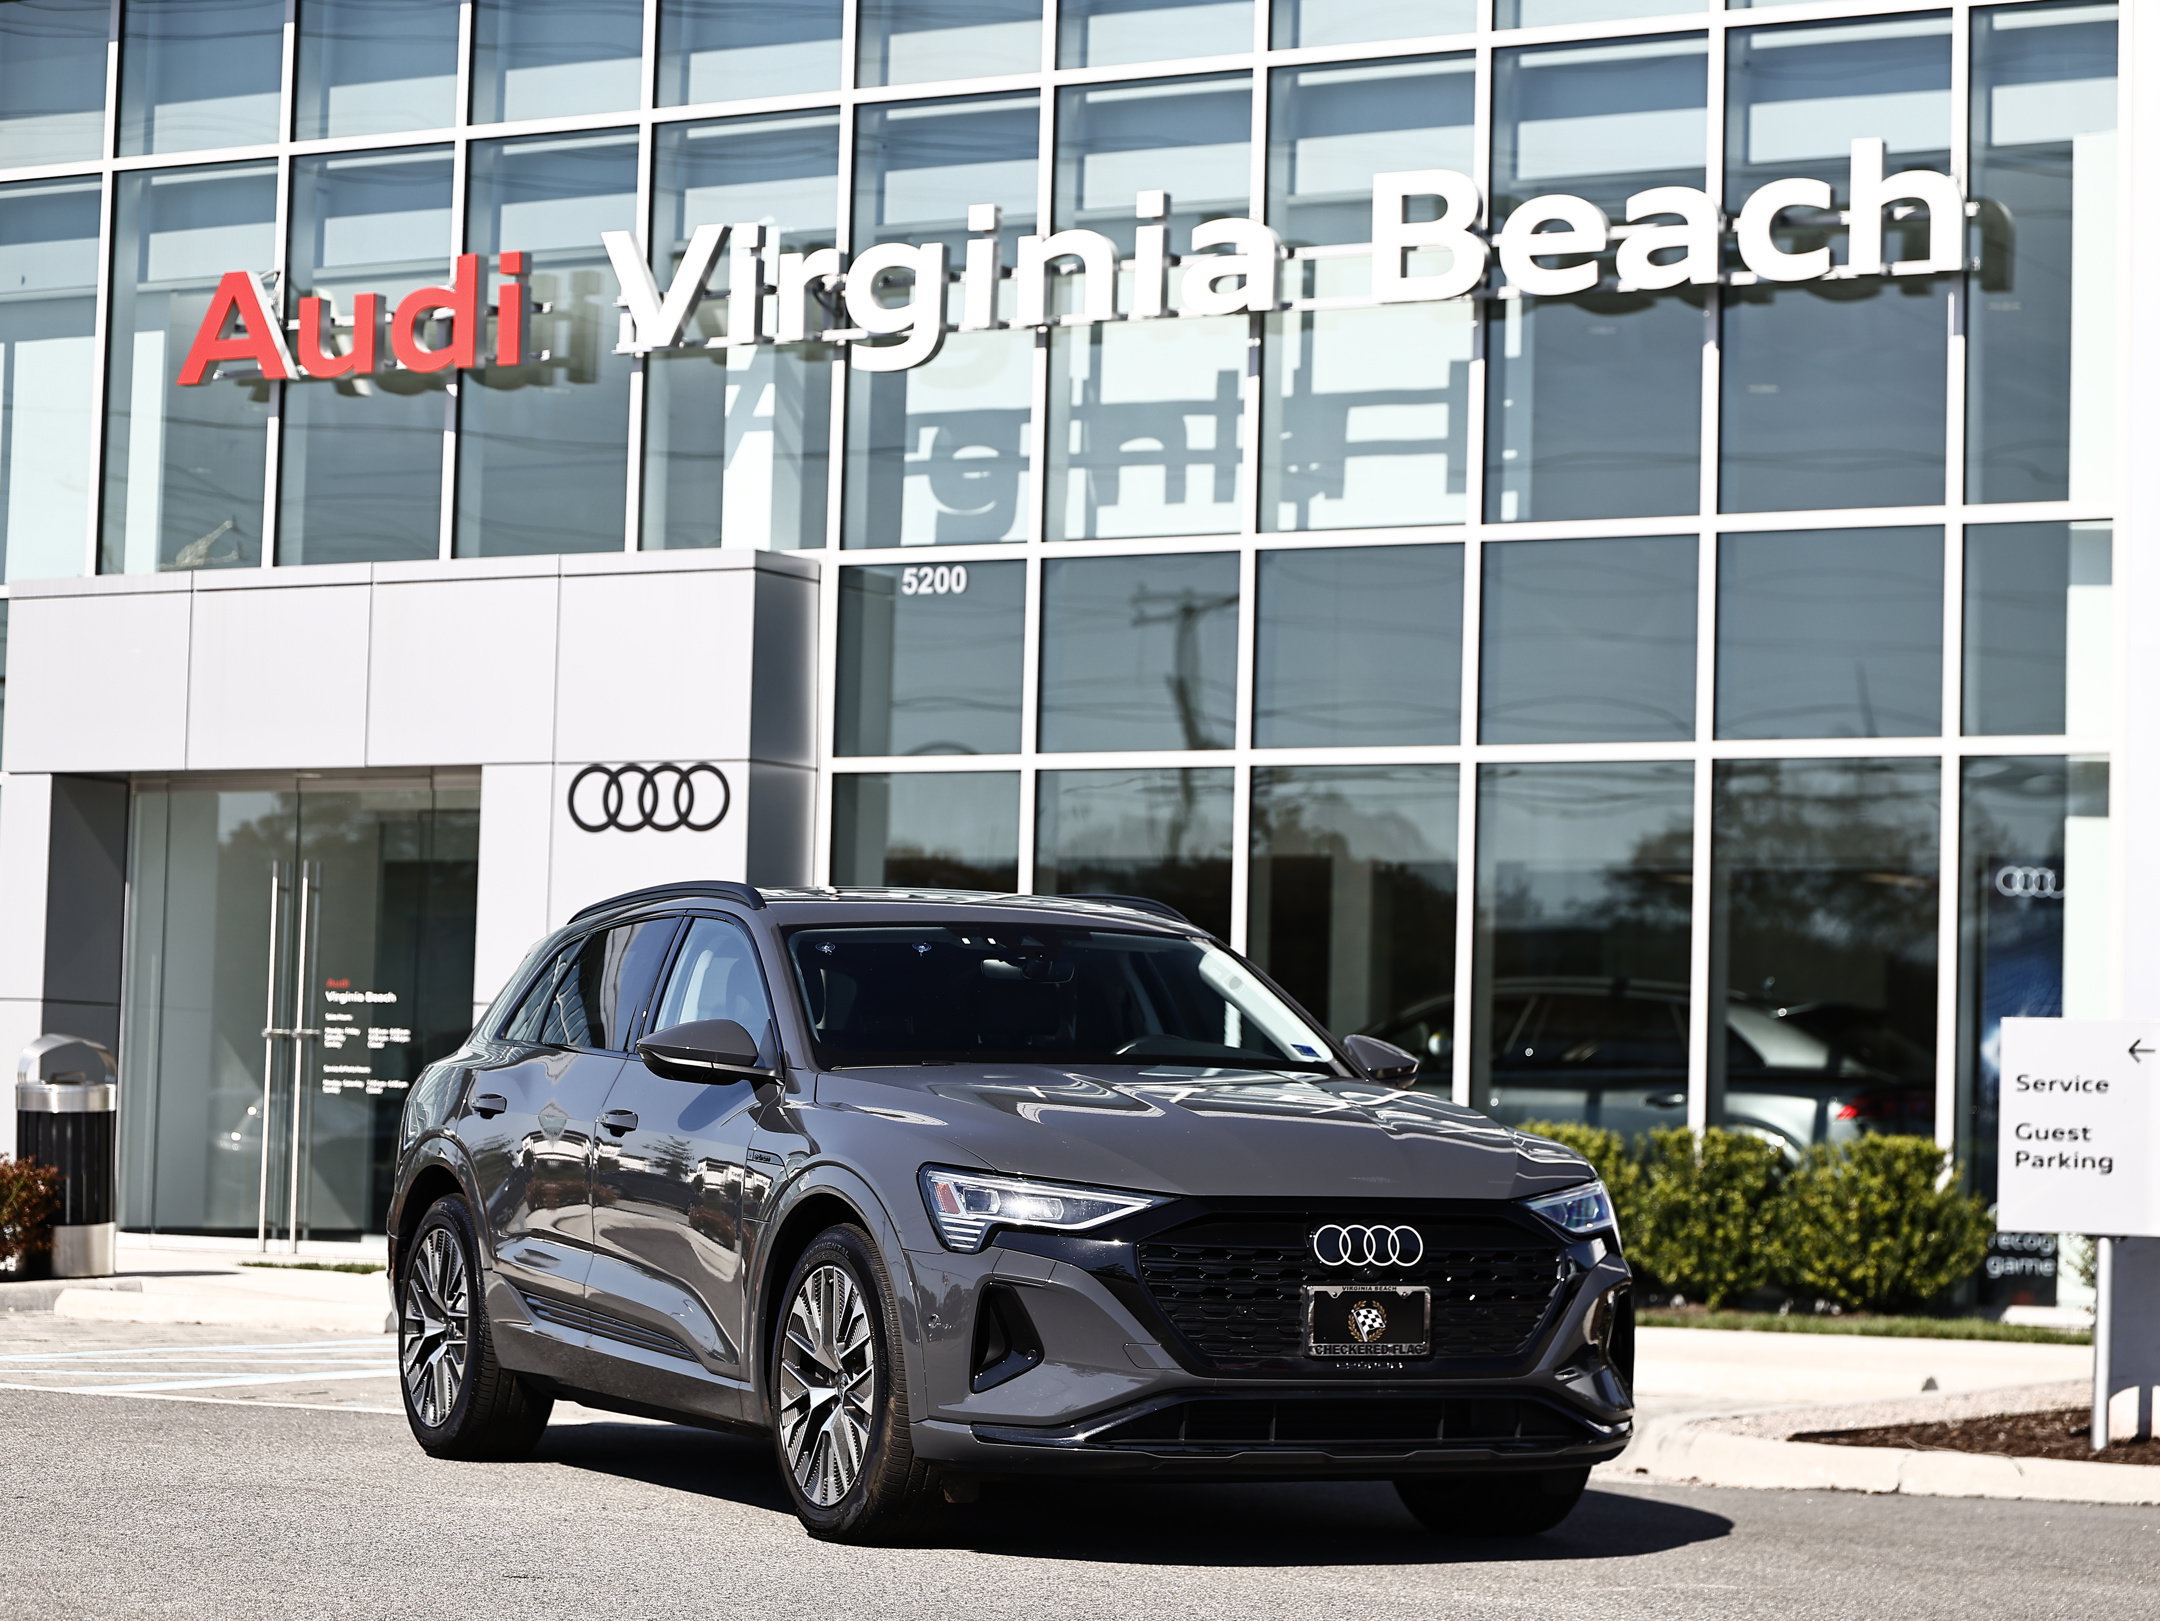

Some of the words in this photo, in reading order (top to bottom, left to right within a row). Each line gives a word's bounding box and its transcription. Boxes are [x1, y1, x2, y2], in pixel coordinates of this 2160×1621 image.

[176, 252, 528, 386] Audi
[602, 189, 1281, 373] Virginia
[1372, 137, 1965, 304] Beach
[901, 565, 967, 595] 5200
[2016, 1074, 2109, 1093] Service
[2015, 1122, 2092, 1141] Guest
[2015, 1150, 2113, 1175] Parking
[1315, 1344, 1388, 1355] CHECKERED
[1392, 1344, 1424, 1355] FLAG
